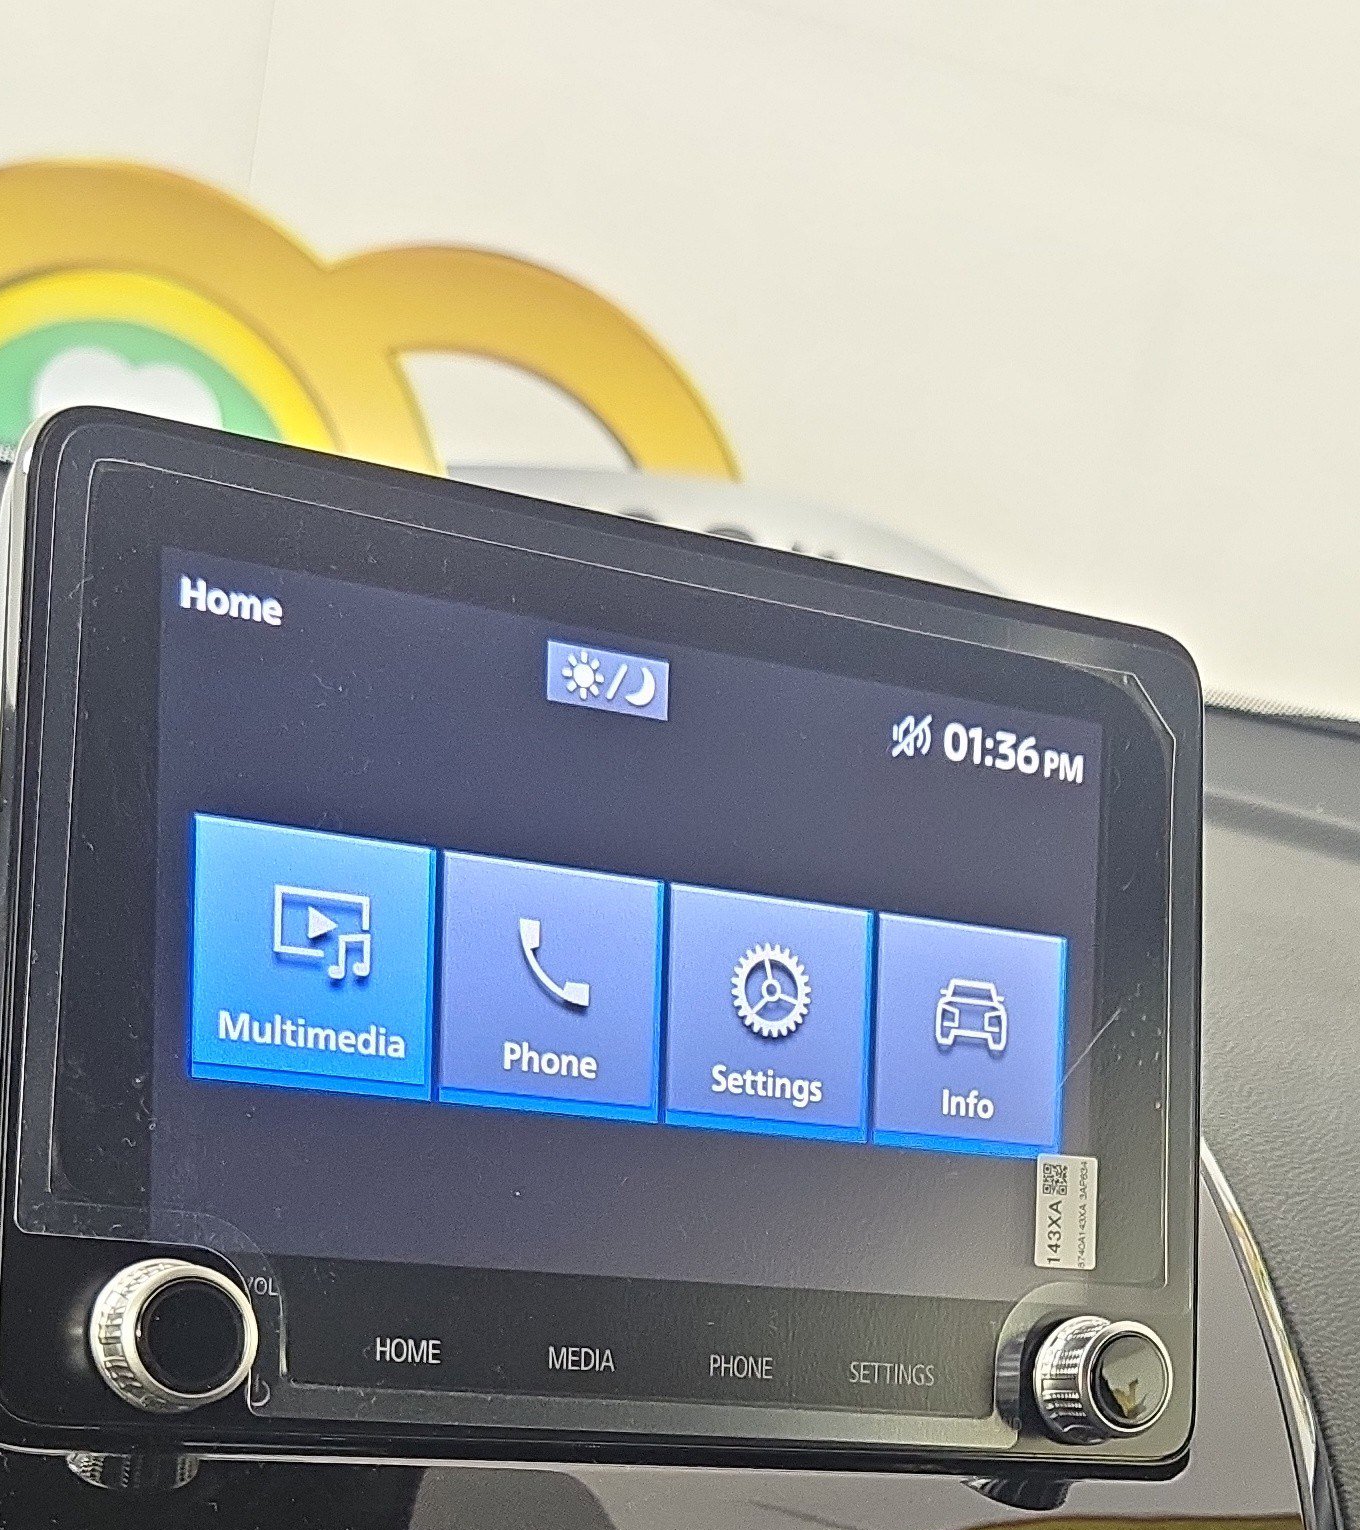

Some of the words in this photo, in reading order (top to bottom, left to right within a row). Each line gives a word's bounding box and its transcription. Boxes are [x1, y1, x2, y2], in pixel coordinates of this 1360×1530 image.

[179, 575, 283, 627] Home
[943, 722, 1039, 775] 01:36
[1043, 750, 1084, 784] PM
[217, 1009, 407, 1060] Multimedia
[502, 1040, 598, 1081] Phone
[710, 1063, 823, 1109] Settings
[941, 1089, 995, 1121] Info
[1045, 1199, 1063, 1266] 143XA
[375, 1336, 442, 1365] HOME
[546, 1346, 616, 1373] MEDIA
[708, 1355, 774, 1380] PHONE
[848, 1361, 935, 1387] SETTINGS
